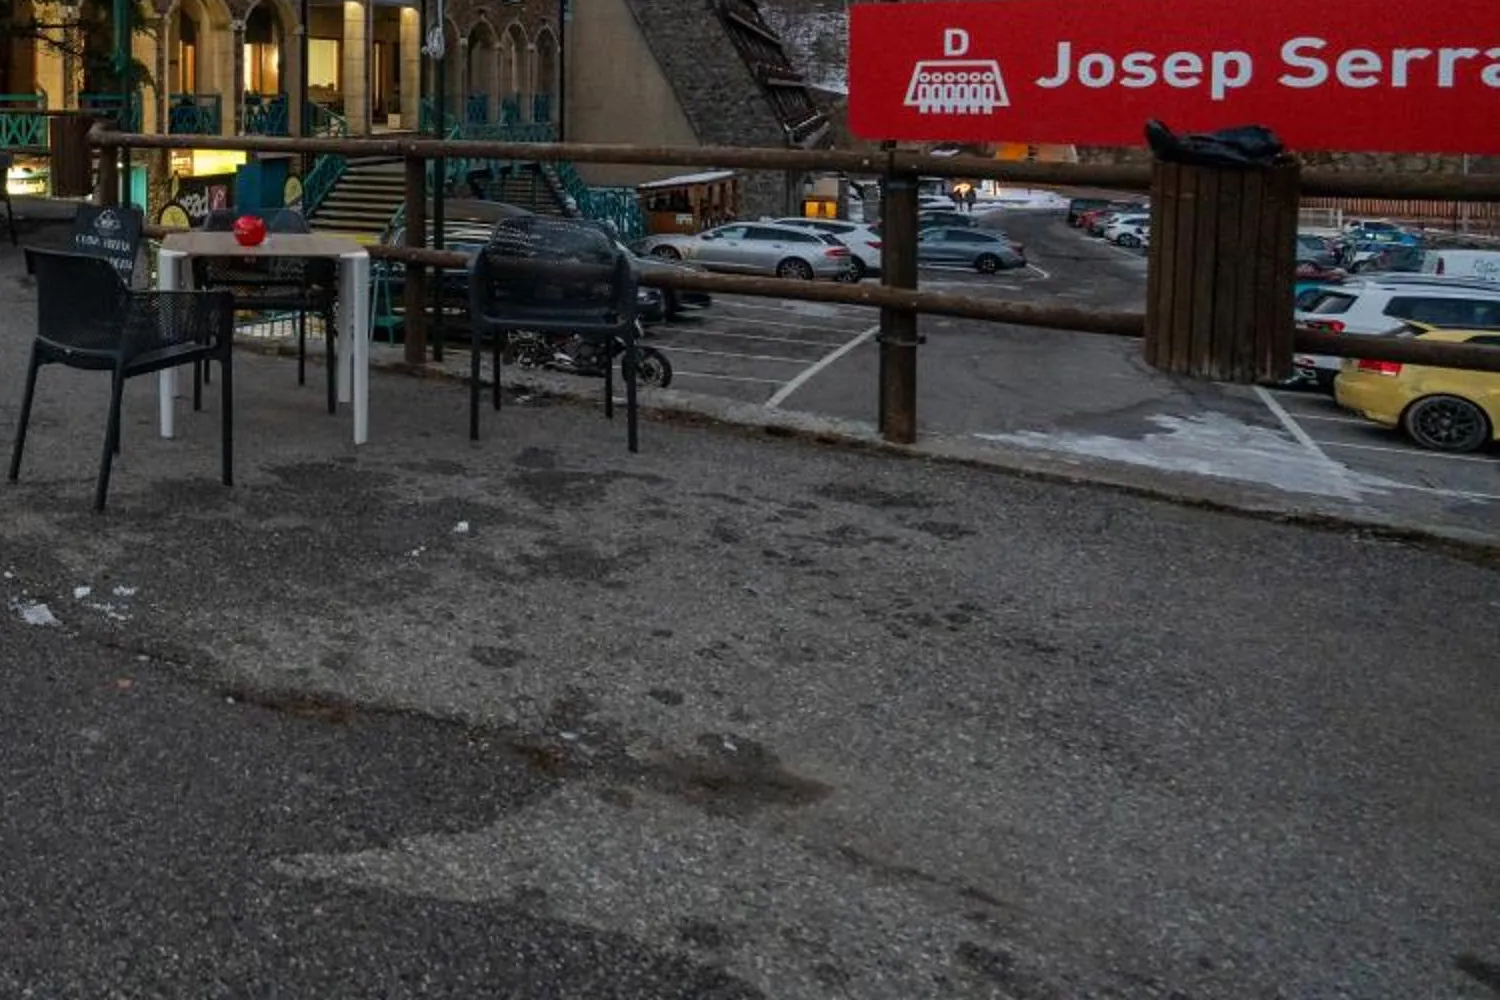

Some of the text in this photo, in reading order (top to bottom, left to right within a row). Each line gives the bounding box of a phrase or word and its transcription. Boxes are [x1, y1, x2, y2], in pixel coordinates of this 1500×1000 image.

[943, 28, 970, 56] D
[1035, 41, 1253, 100] Josep
[178, 186, 209, 217] ead
